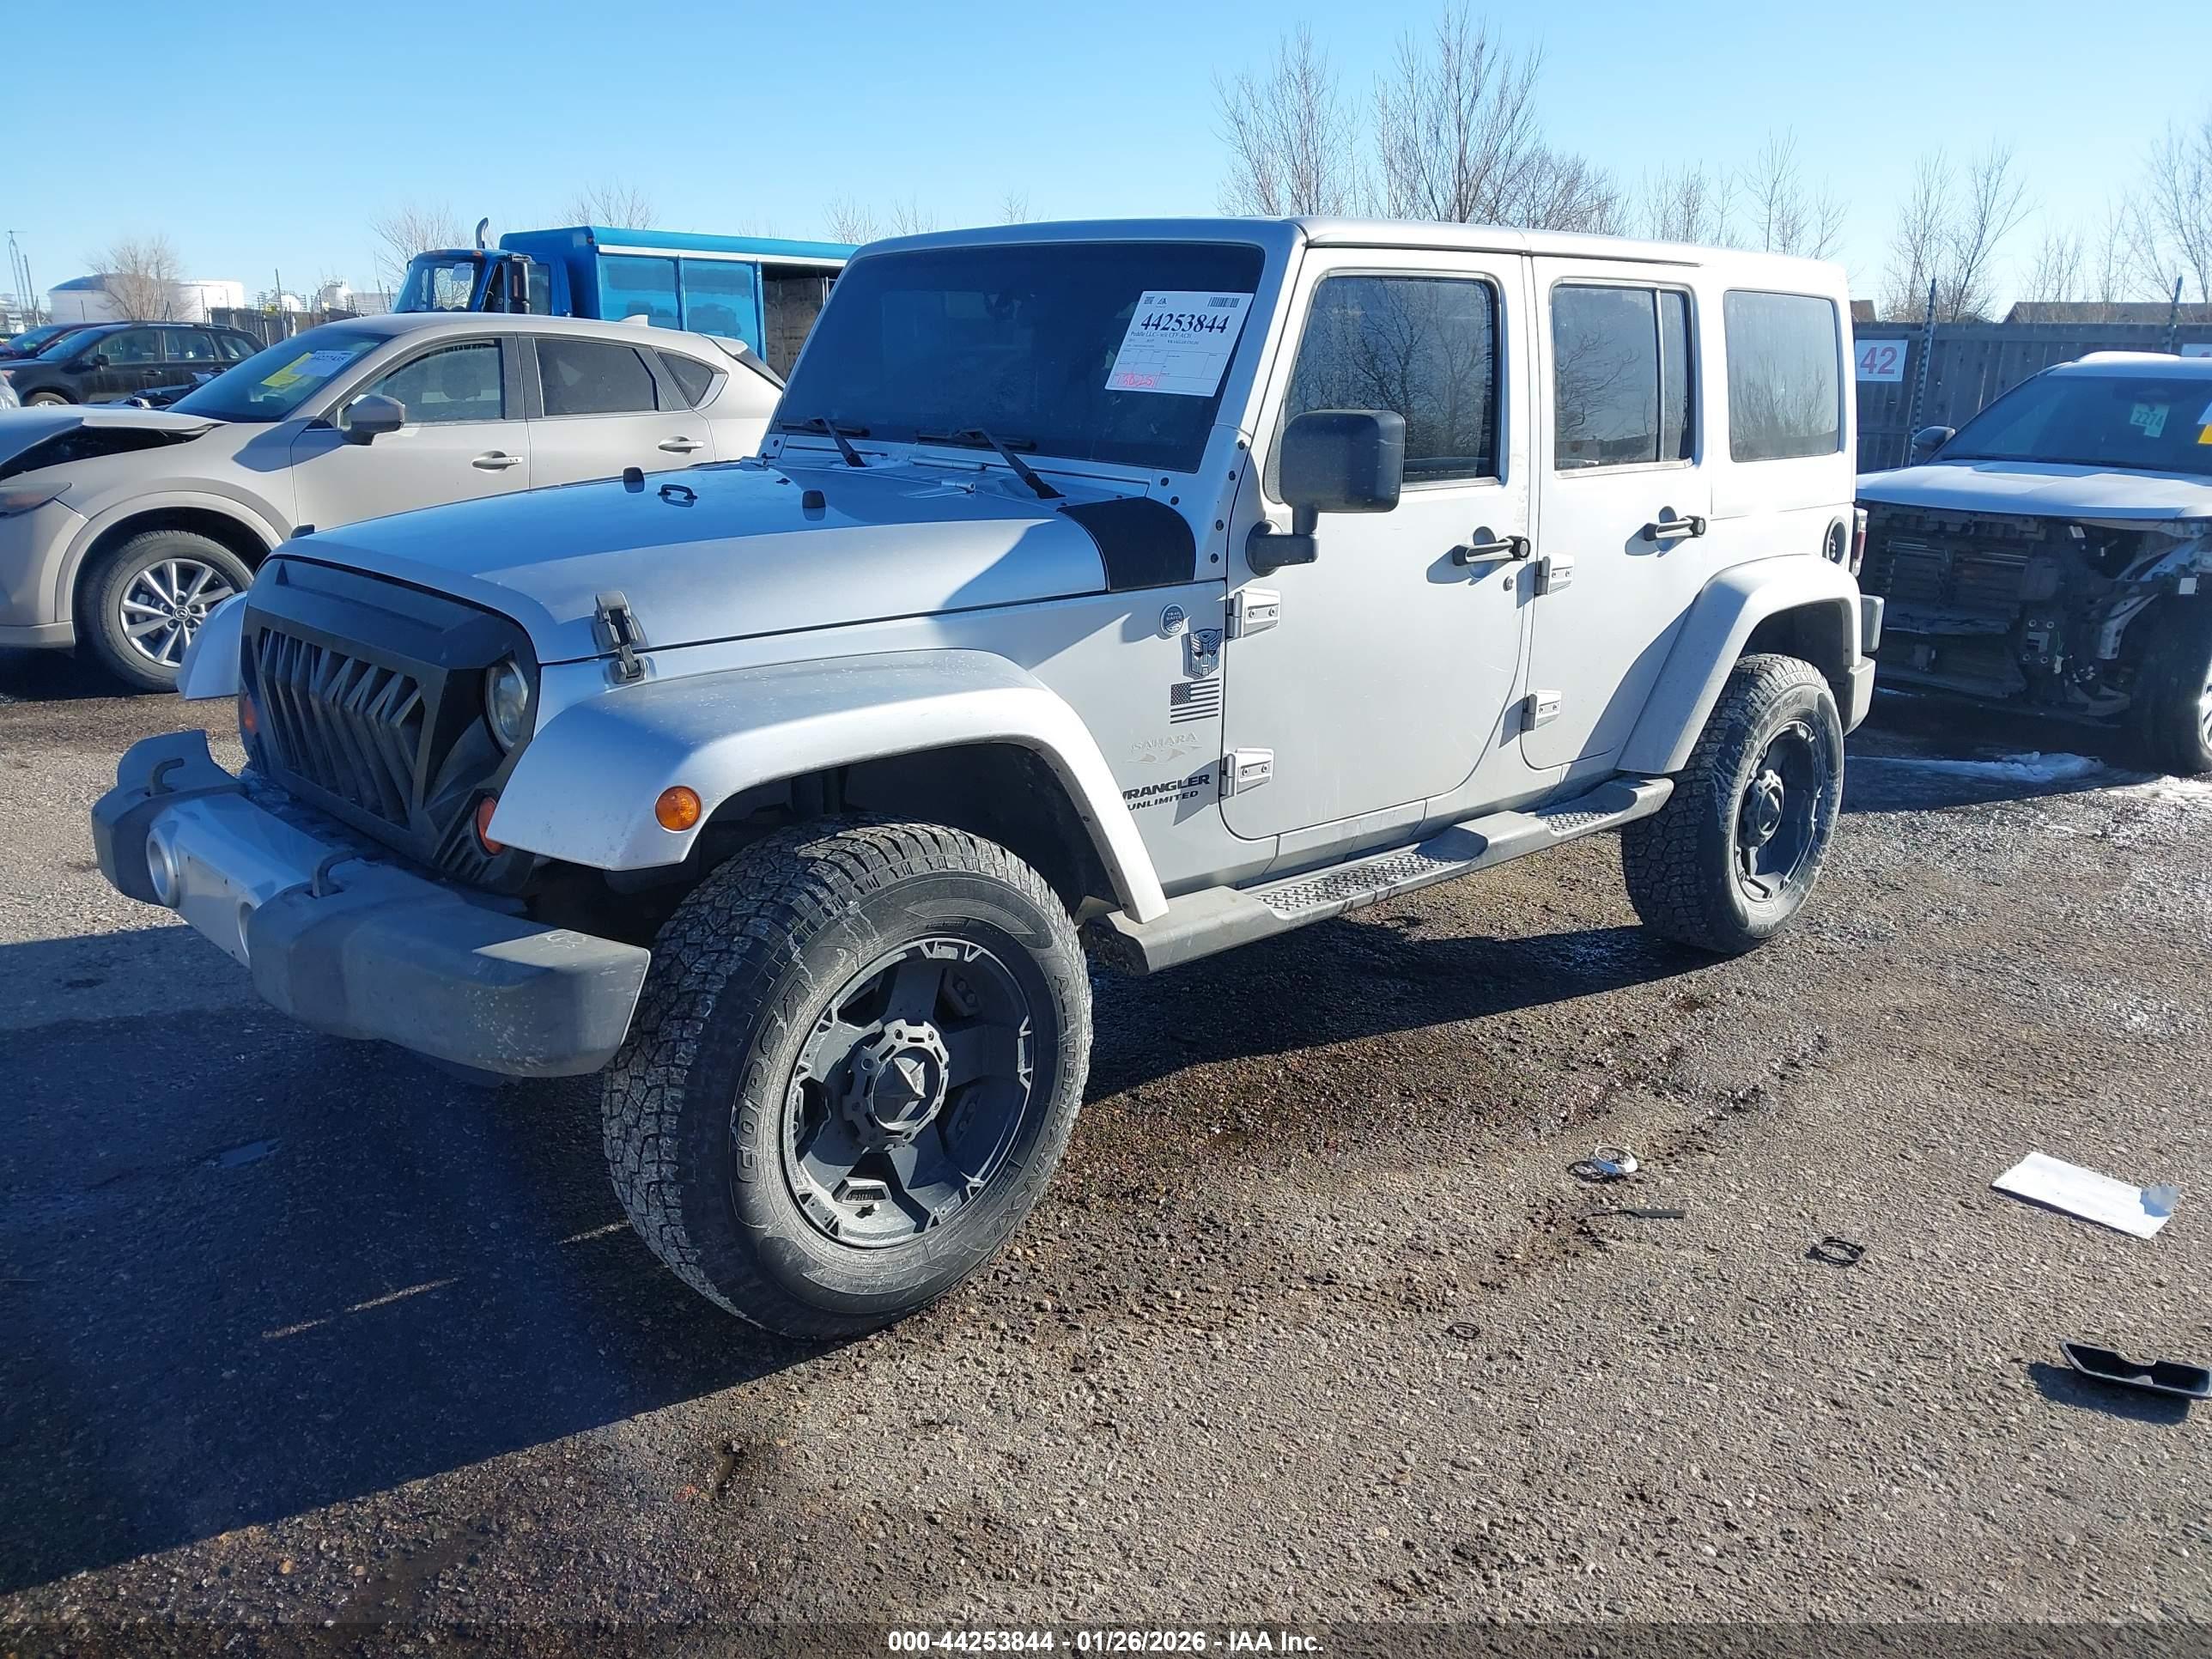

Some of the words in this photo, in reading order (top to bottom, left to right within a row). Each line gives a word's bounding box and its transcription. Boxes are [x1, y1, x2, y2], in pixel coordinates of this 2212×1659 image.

[1140, 312, 1231, 333] 44253844
[1860, 346, 1898, 374] 42
[1130, 732, 1199, 754] SAHARA
[1127, 790, 1199, 811] UNLIMITED
